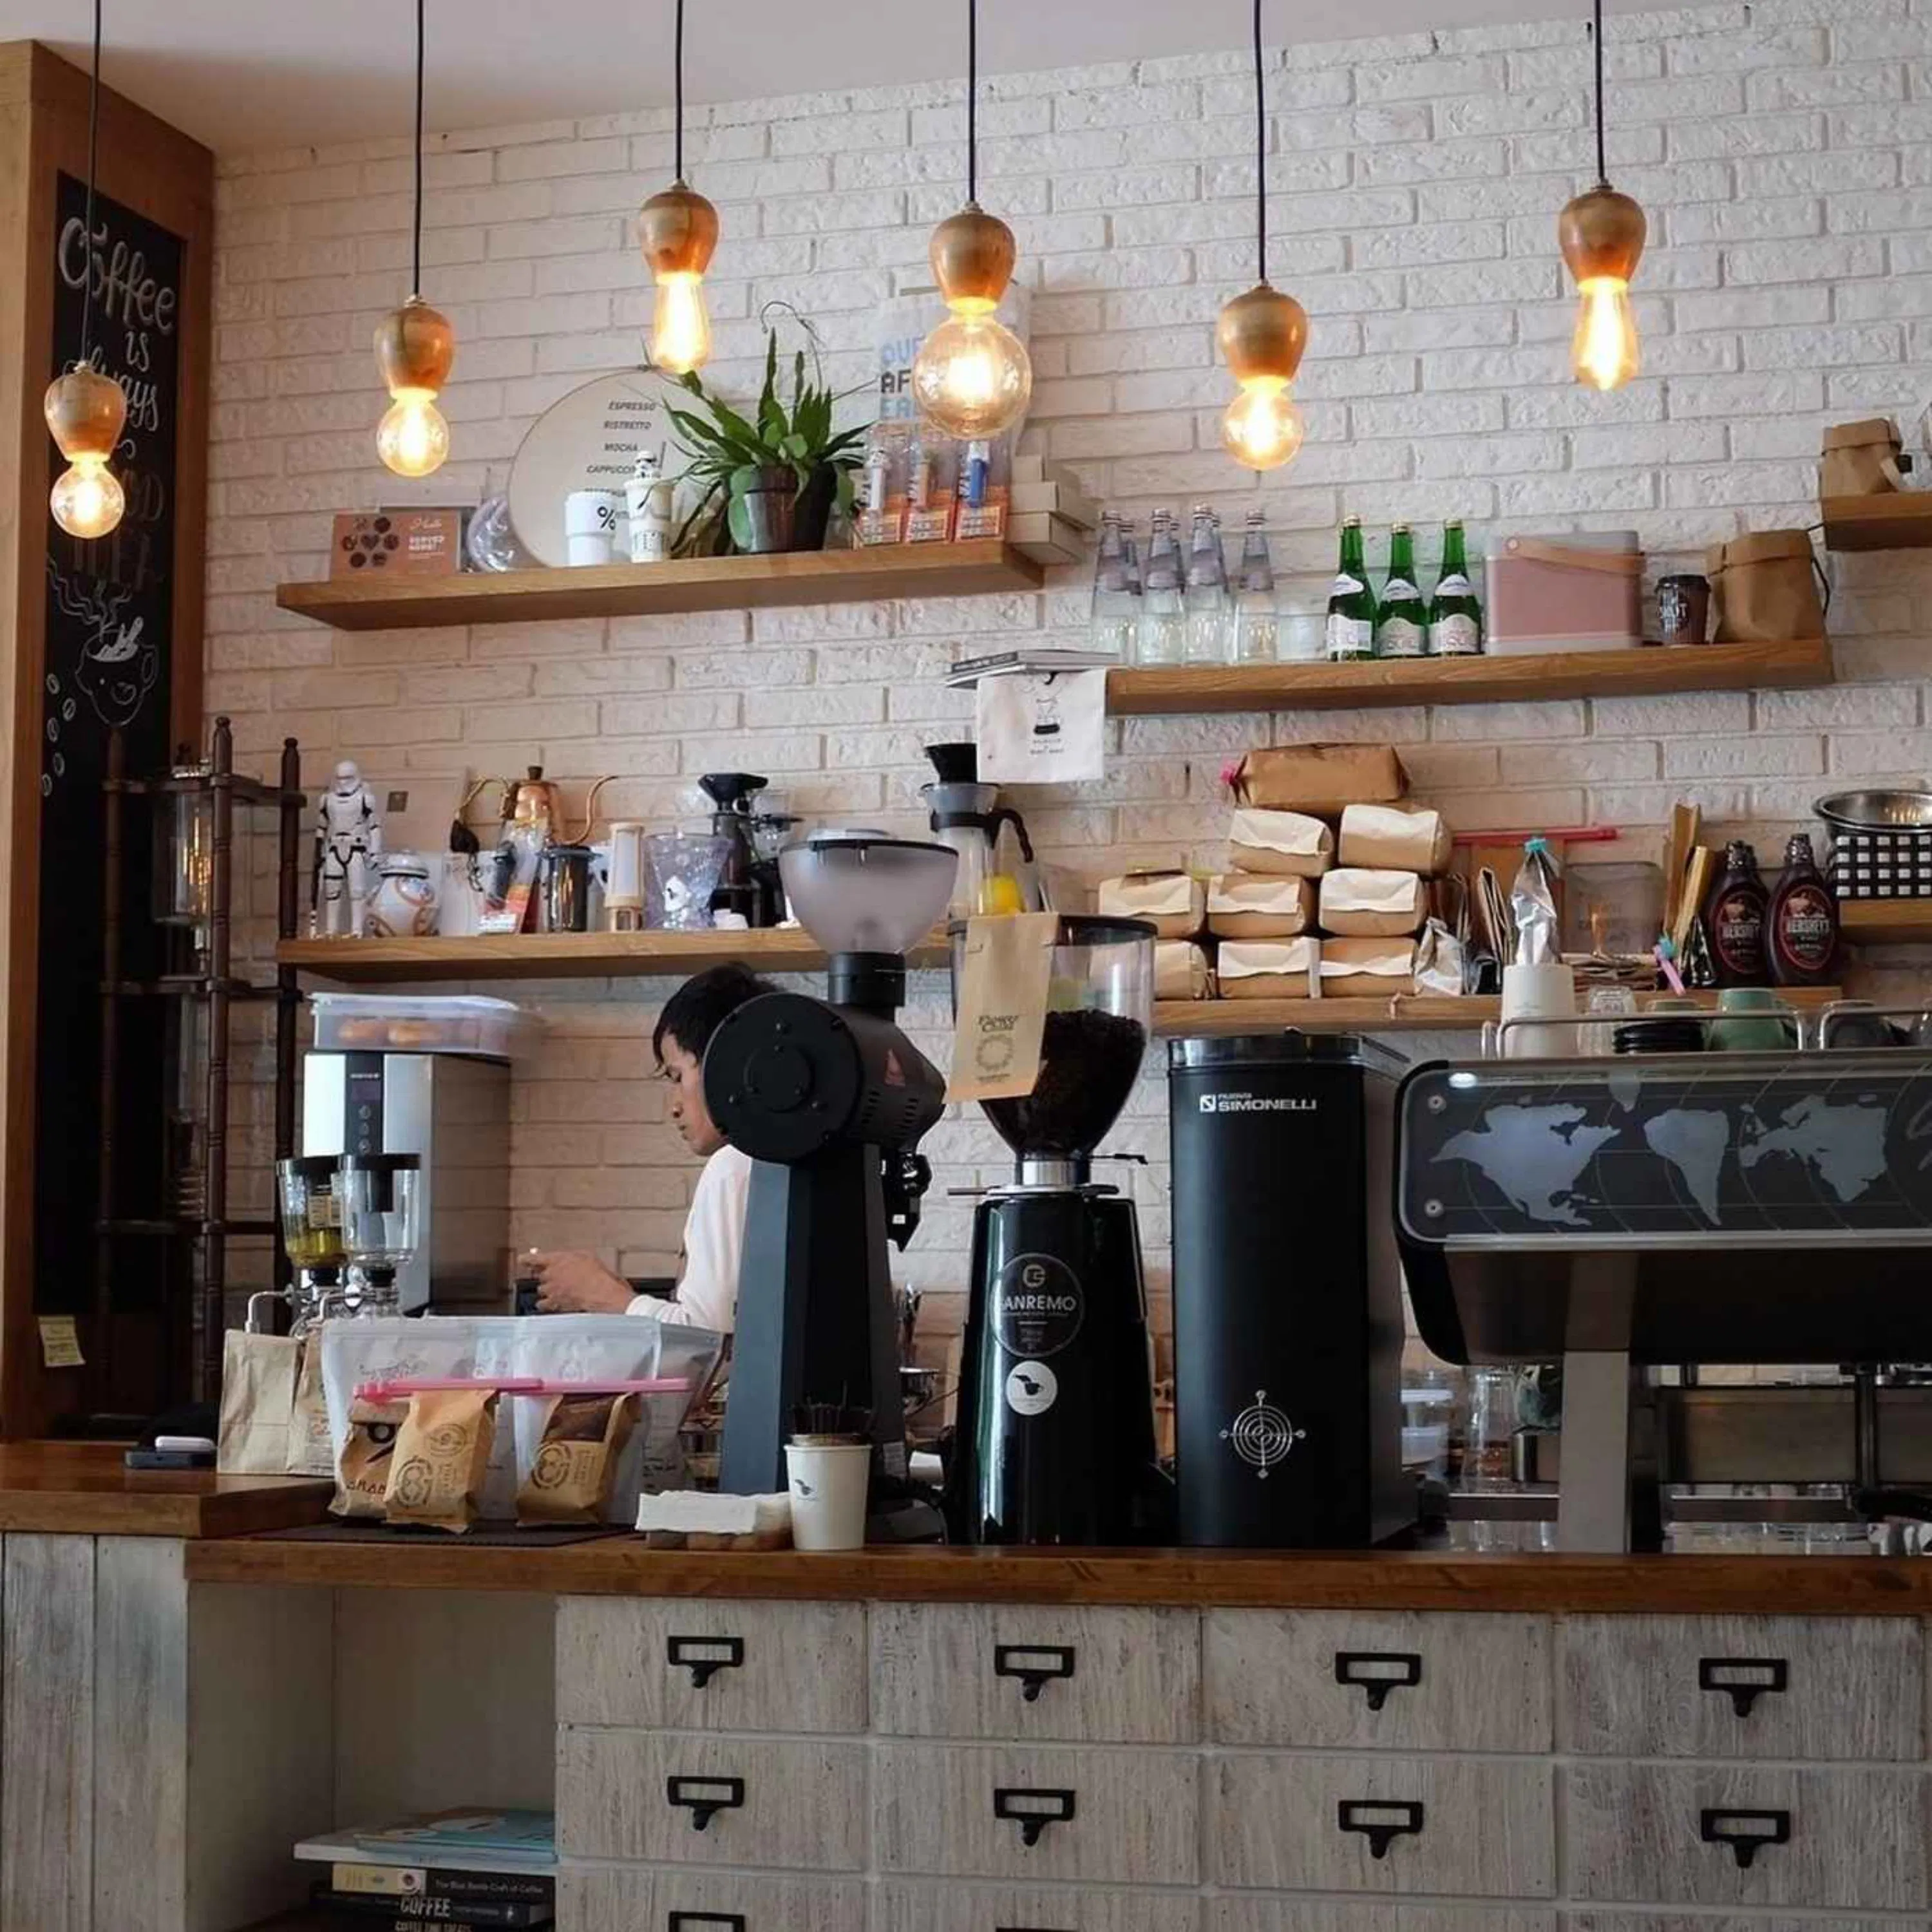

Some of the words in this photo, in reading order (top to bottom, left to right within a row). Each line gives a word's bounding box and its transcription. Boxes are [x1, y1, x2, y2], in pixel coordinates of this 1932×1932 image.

[58, 216, 176, 336] Coffee
[124, 331, 150, 372] is
[608, 401, 656, 410] ESPRESSO
[603, 421, 652, 430] RISTRETTO
[605, 442, 638, 451] MOCHA
[1218, 1099, 1317, 1112] SIMONELLI
[998, 1295, 1076, 1311] ANREMO
[400, 1896, 451, 1917] COFFEE
